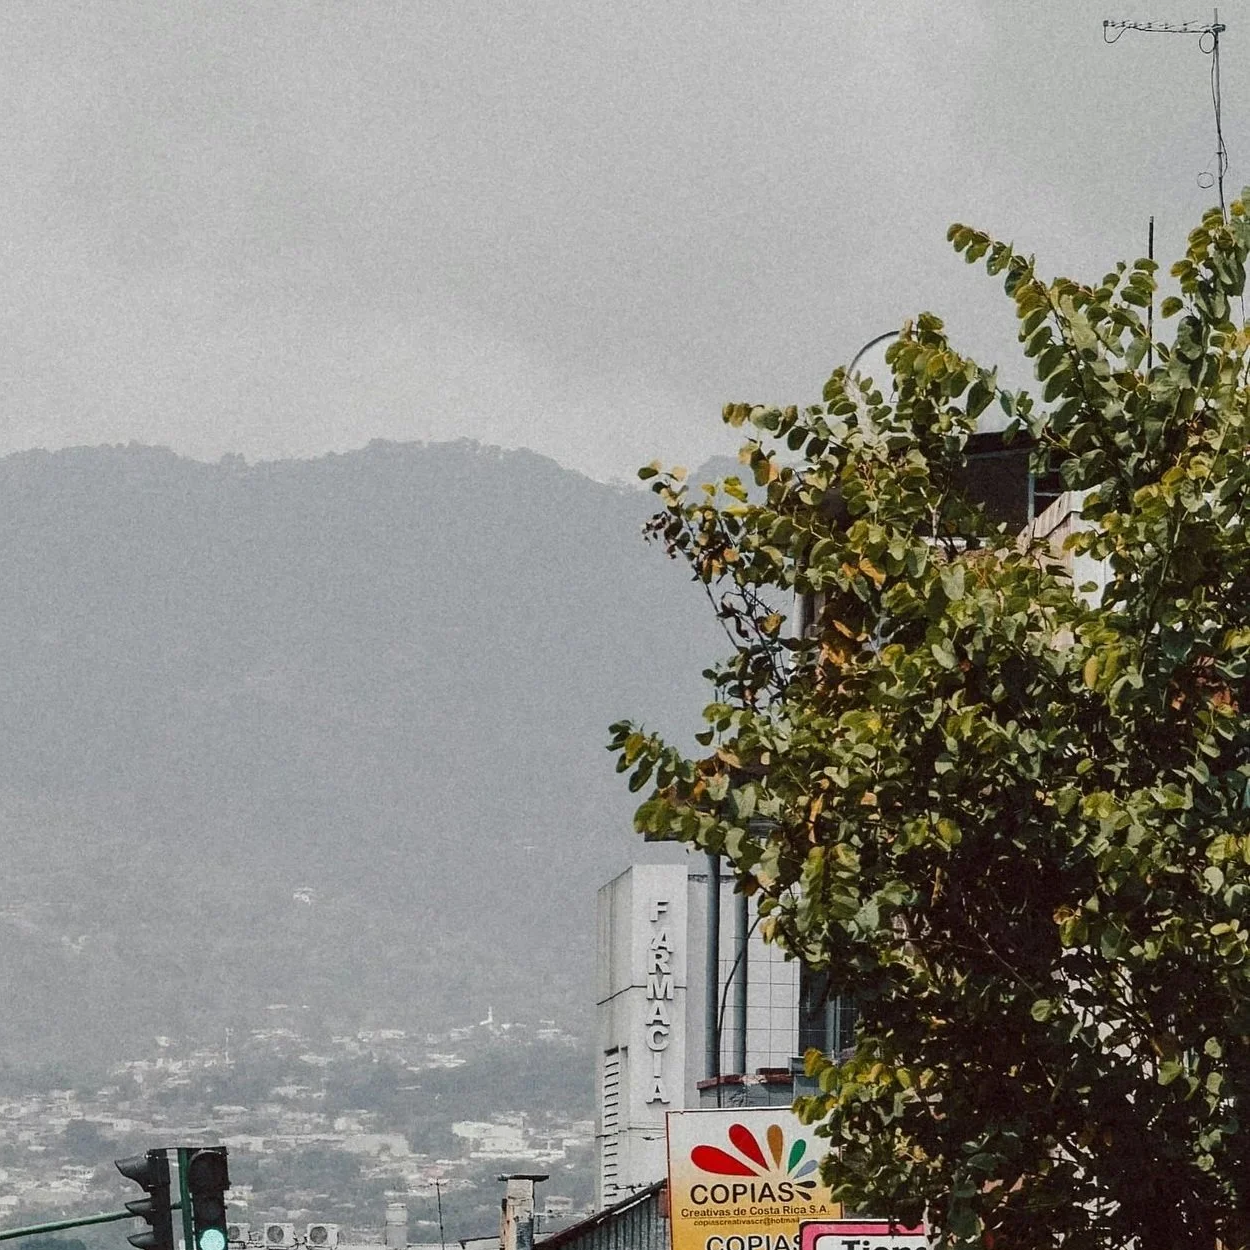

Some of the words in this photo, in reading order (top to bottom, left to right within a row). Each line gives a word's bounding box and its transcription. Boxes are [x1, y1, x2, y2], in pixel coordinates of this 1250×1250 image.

[645, 901, 674, 1104] FARMACIA
[690, 1181, 795, 1205] COPIAS
[681, 1208, 730, 1218] Creativas
[733, 1208, 747, 1217] de
[749, 1206, 780, 1216] Costa
[782, 1205, 807, 1215] Rica
